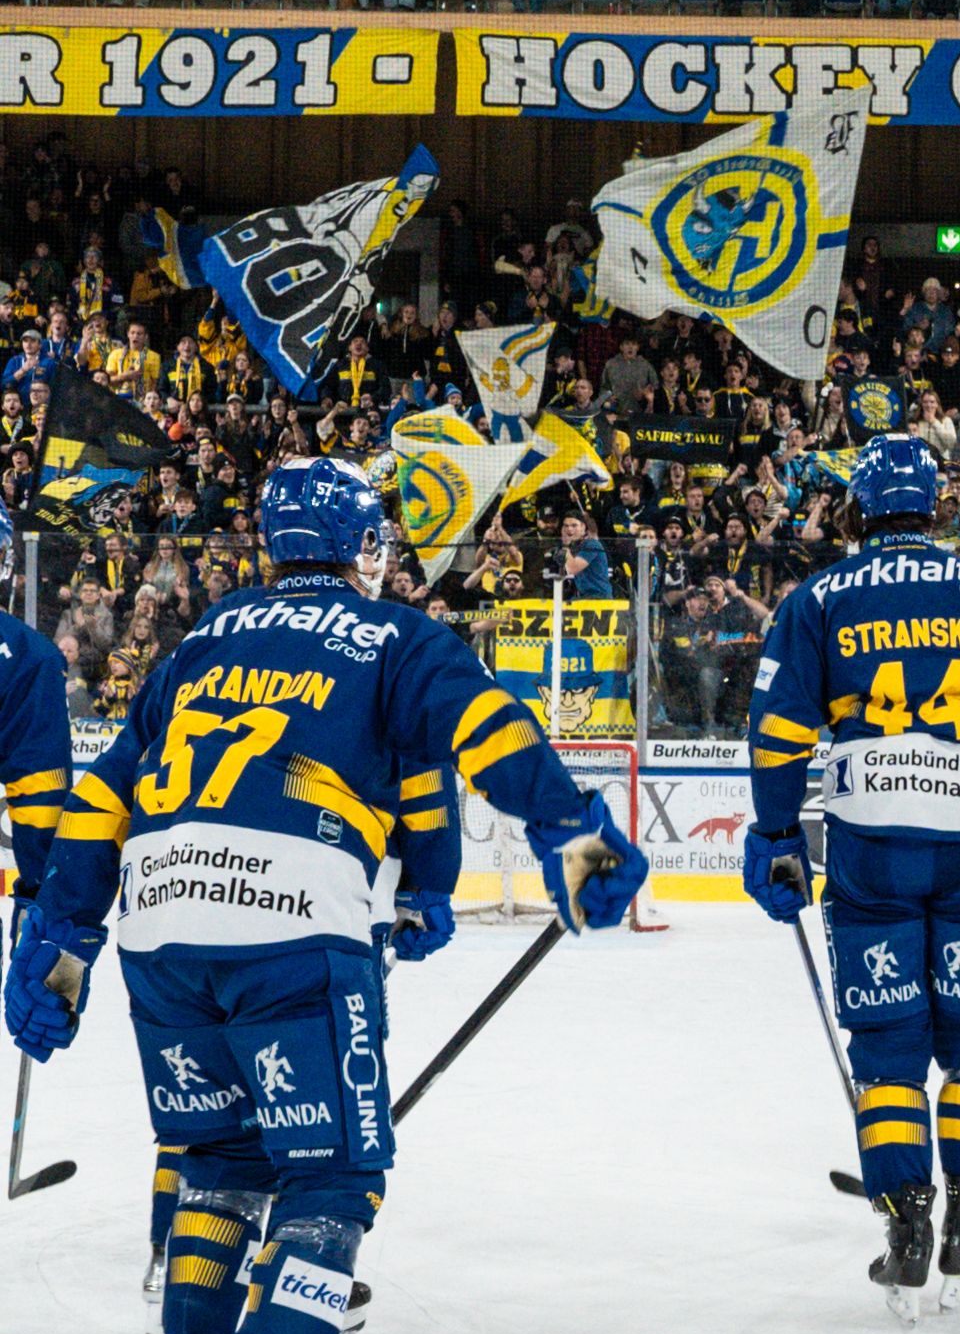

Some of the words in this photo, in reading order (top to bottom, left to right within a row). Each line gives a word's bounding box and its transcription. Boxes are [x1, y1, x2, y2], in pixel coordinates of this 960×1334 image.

[100, 34, 337, 107] 1921
[480, 35, 924, 117] HOCKEY
[316, 482, 332, 496] 57
[277, 574, 345, 590] enovetic
[324, 637, 376, 663] Group
[138, 706, 290, 816] 57
[653, 744, 739, 759] Burkhalter
[700, 781, 746, 798] Office
[141, 844, 272, 878] Graubündner
[689, 850, 745, 869] Füchse
[138, 876, 313, 919] Kantonalbank
[845, 980, 921, 1010] CALANDA
[345, 993, 370, 1057] BAU
[152, 1084, 246, 1113] CALANDA
[256, 1101, 332, 1129] ALANDA
[355, 1083, 380, 1152] LINK
[288, 1147, 334, 1158] BAUER
